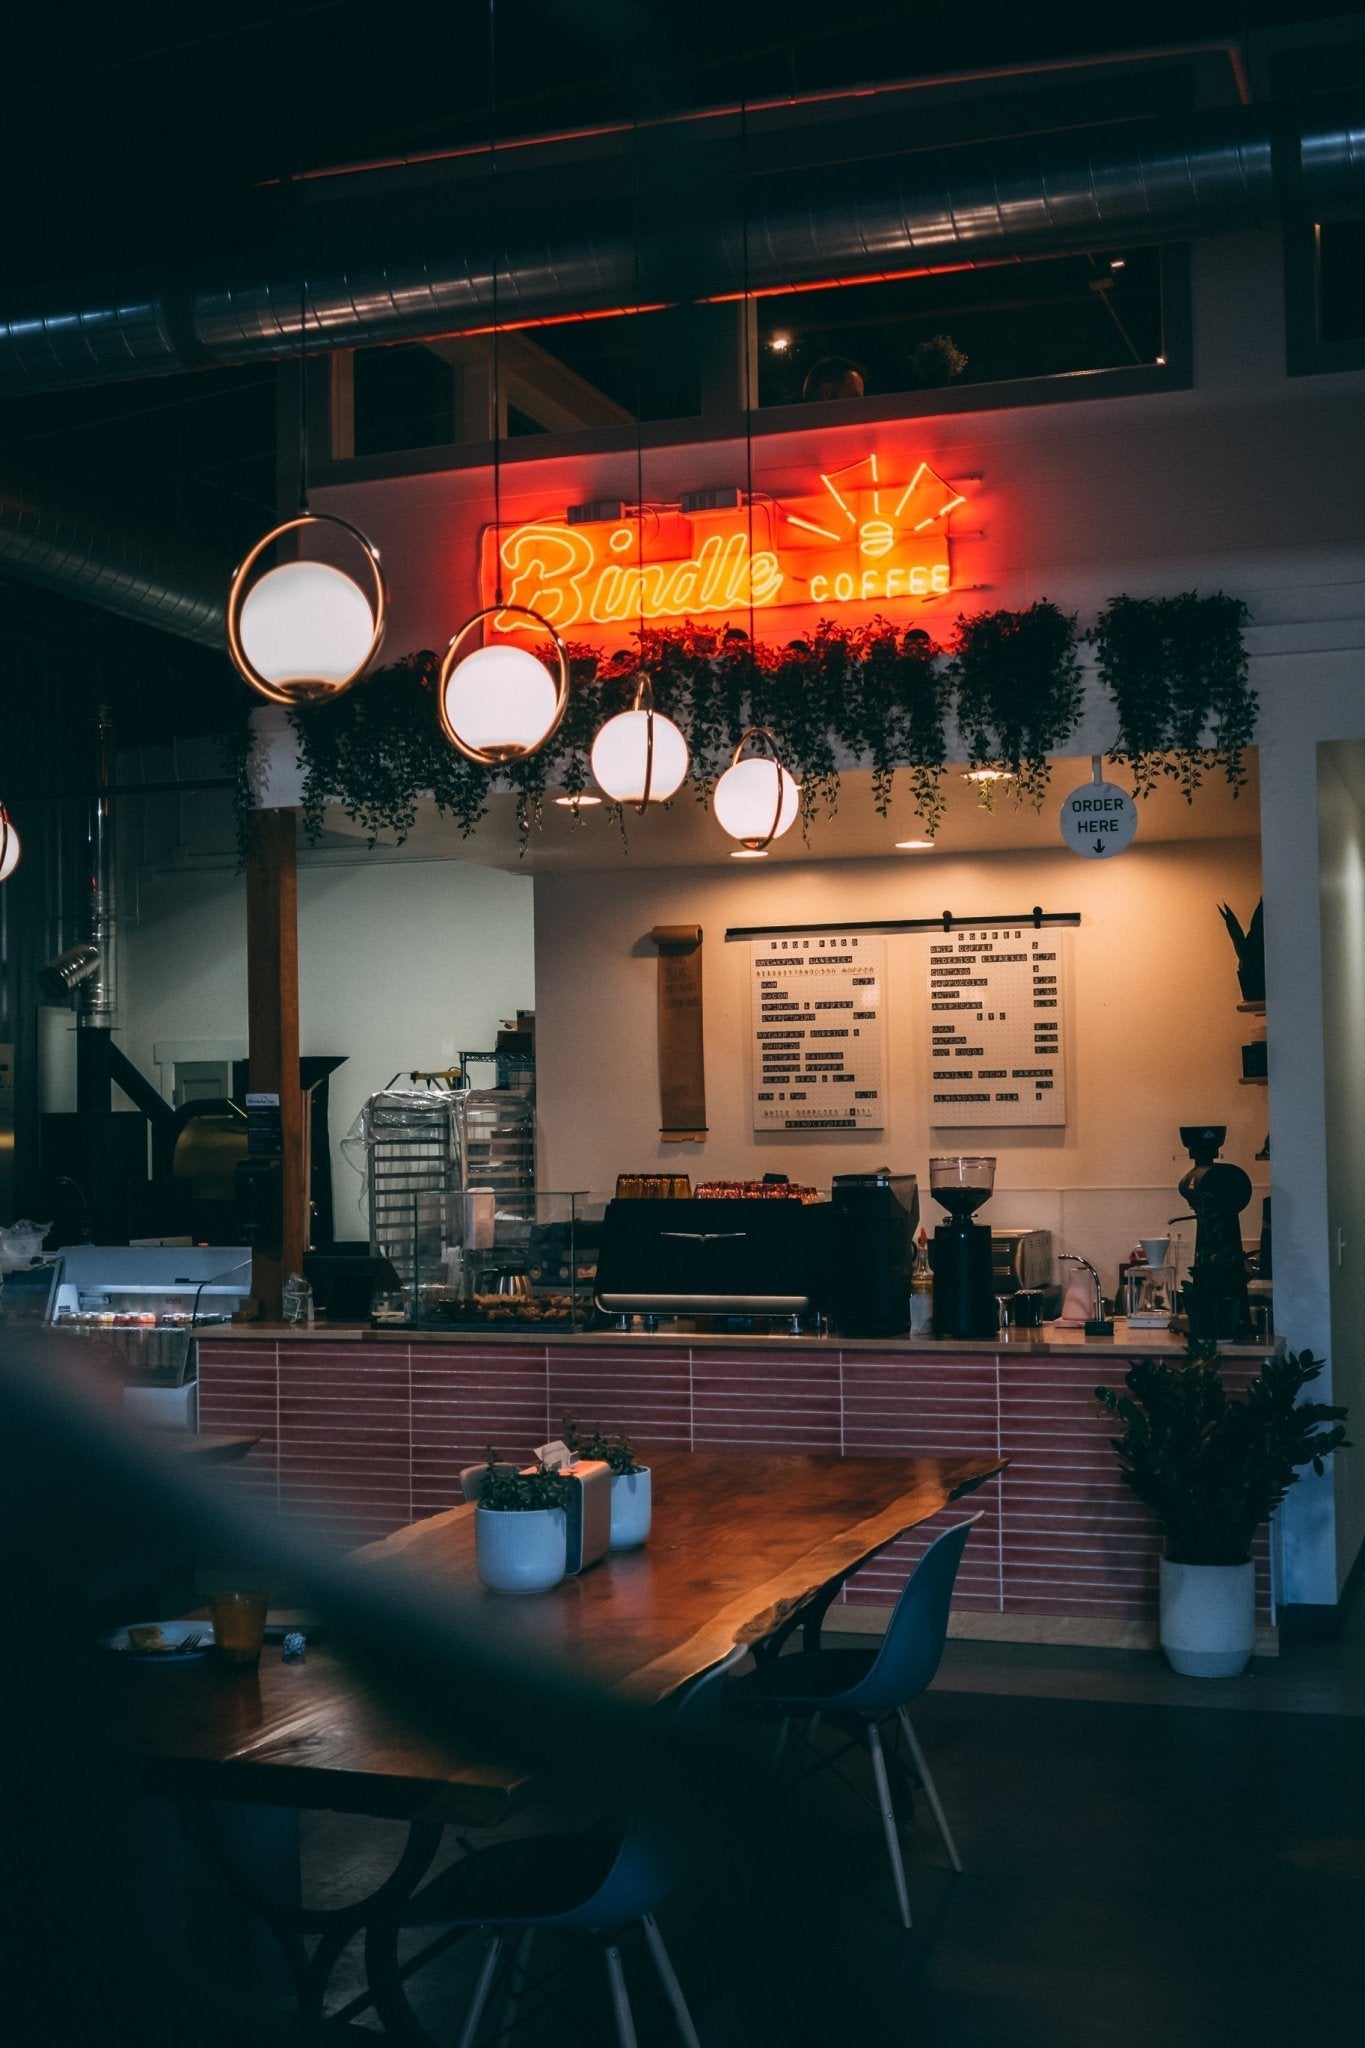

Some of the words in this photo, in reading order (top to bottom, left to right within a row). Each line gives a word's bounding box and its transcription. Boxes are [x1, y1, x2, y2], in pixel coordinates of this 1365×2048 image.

[494, 525, 784, 632] Bindle
[810, 564, 950, 603] COFFEE
[1072, 798, 1124, 812] ORDER
[1078, 819, 1119, 833] HERE
[958, 931, 1021, 941] COFFEE
[931, 945, 953, 953] DRIP
[959, 944, 992, 952] COFFEE
[756, 958, 804, 967] BREAKFAST
[809, 956, 852, 964] SANDWICH
[931, 956, 976, 965] SIDEKICK
[981, 954, 1027, 963] ESPRESSO
[931, 967, 970, 976] CORTADO
[931, 978, 988, 987] CAPPUCCINO
[761, 992, 788, 1000] BACON
[762, 1002, 799, 1011] SPINACH
[815, 1001, 853, 1010] PEPPERS
[932, 1002, 982, 1010] AMERICANO
[762, 1013, 816, 1022] EVERYTHING
[932, 1025, 955, 1033] CHAI
[757, 1030, 805, 1039] BREAKFAST
[810, 1029, 848, 1038] BURRITO
[932, 1036, 967, 1045] MATCHA
[933, 1048, 950, 1056] HOT
[955, 1048, 983, 1056] COCOA
[933, 1071, 973, 1079] VANILLA
[978, 1070, 1007, 1078] MOCHA
[1012, 1069, 1053, 1078] CARAMEL
[996, 1093, 1019, 1101] MILK
